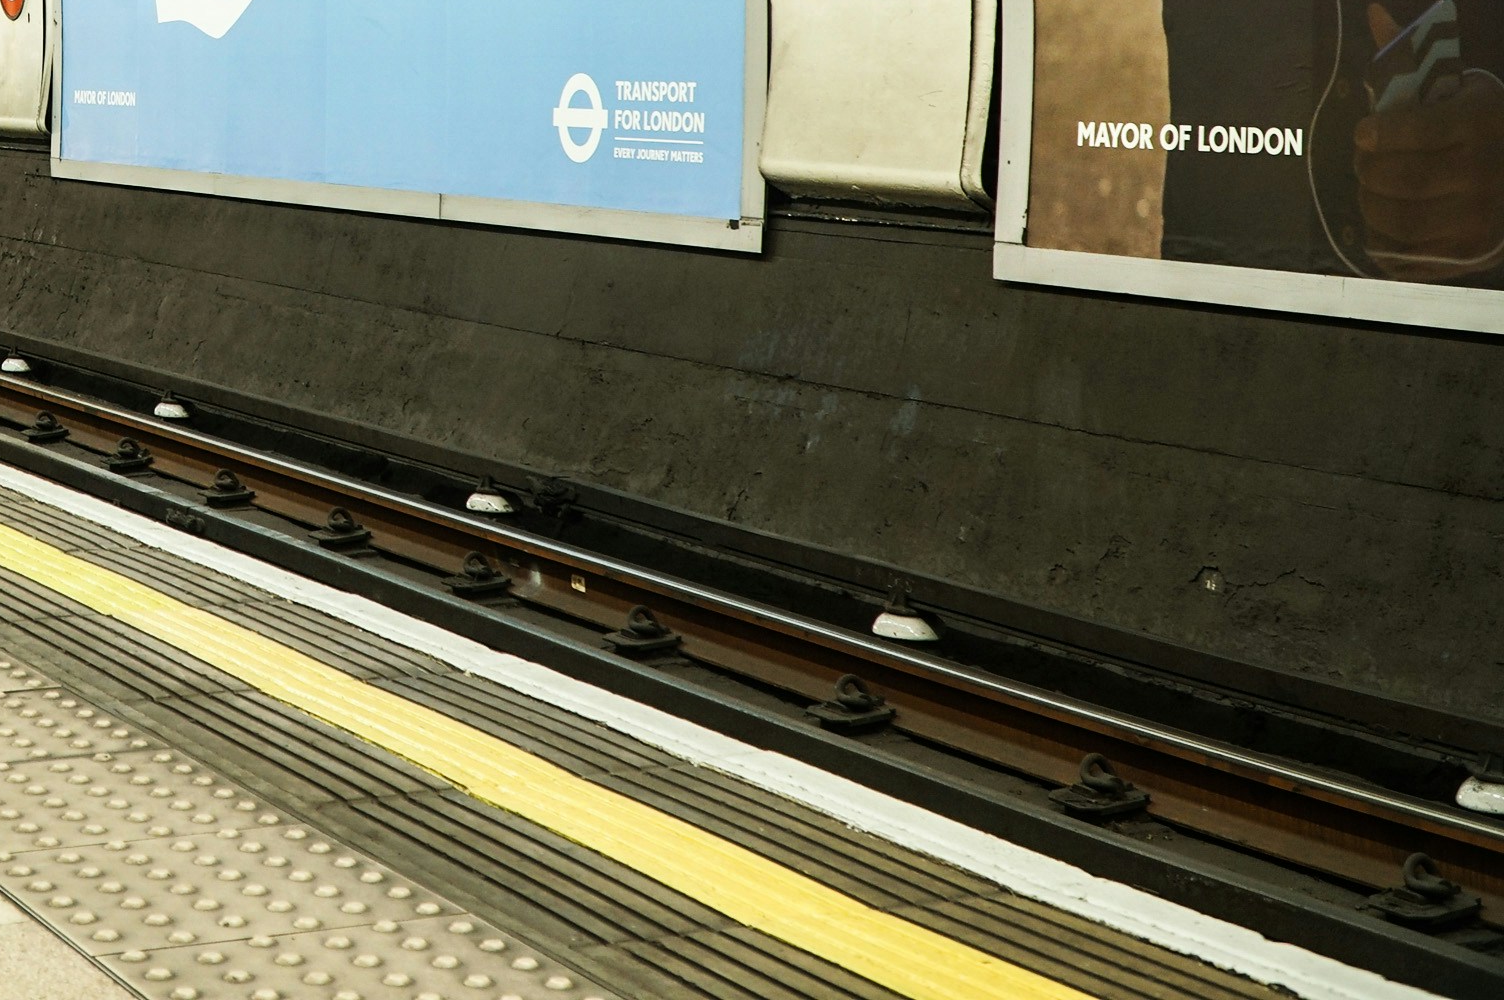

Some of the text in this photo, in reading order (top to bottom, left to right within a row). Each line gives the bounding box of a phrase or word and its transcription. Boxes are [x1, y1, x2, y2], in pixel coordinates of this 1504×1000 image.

[74, 89, 136, 107] MAYOR OF LONDON
[615, 80, 697, 103] TRANSPORT
[614, 110, 705, 134] FOR LONDON
[1077, 121, 1303, 156] MAYOR OF LONDON
[614, 147, 704, 164] EVERY JOURNEY MATTERS
